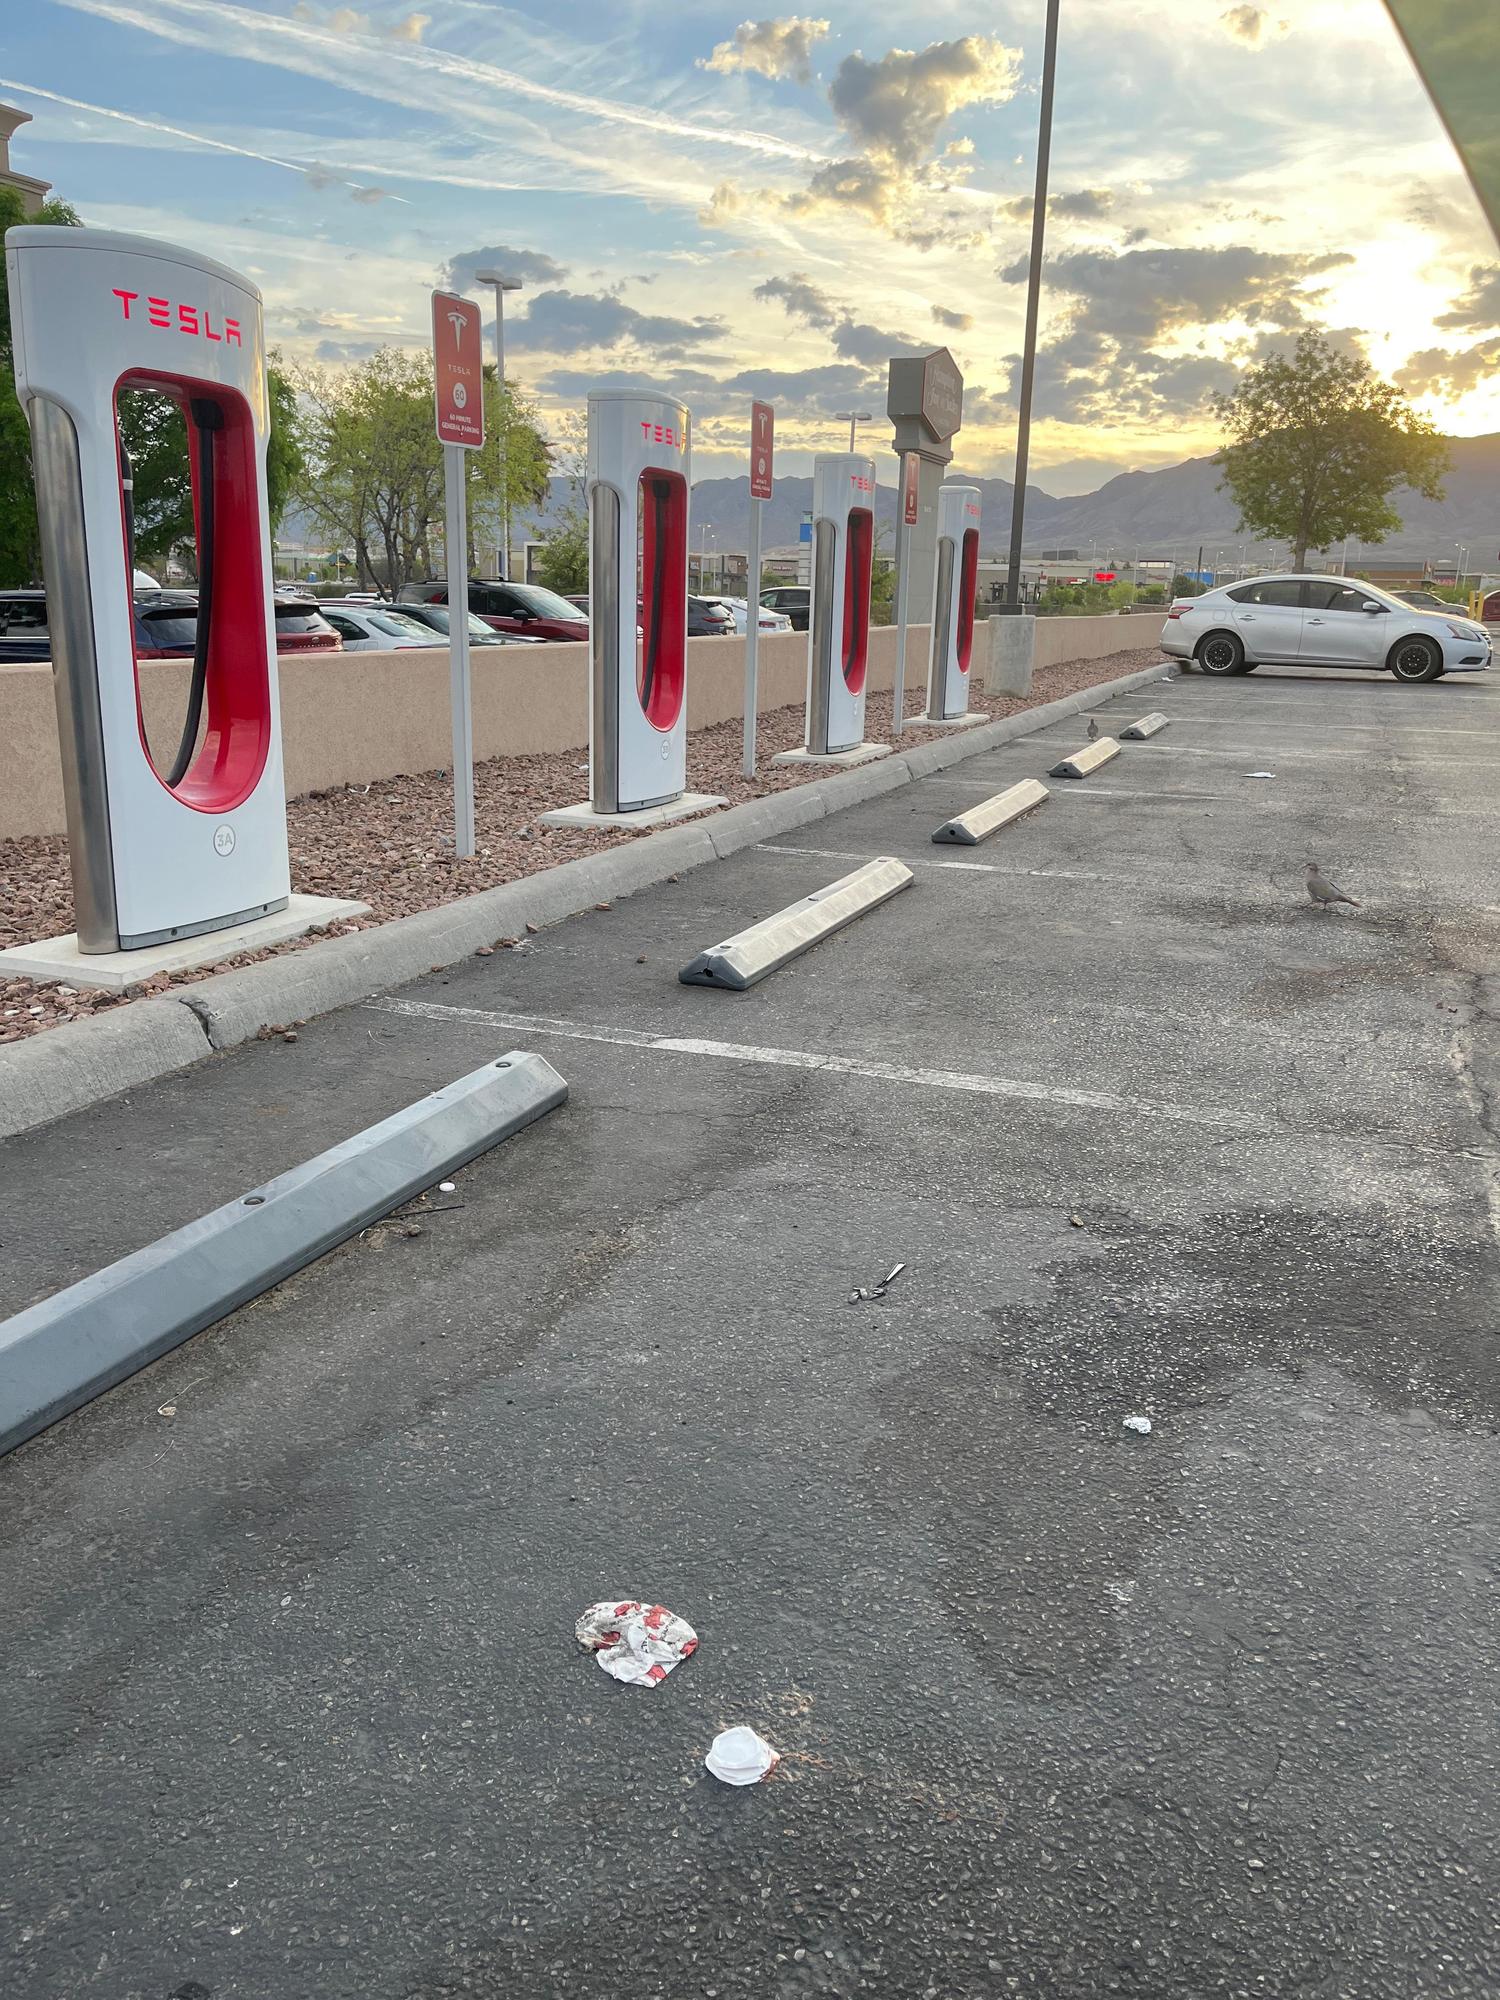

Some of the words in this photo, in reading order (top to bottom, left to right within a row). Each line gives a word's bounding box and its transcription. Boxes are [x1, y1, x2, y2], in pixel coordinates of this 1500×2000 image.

[112, 289, 242, 347] TESLA
[448, 364, 471, 376] TESLA
[455, 389, 465, 401] 60
[640, 422, 687, 449] TESLA
[217, 832, 233, 847] 3A
